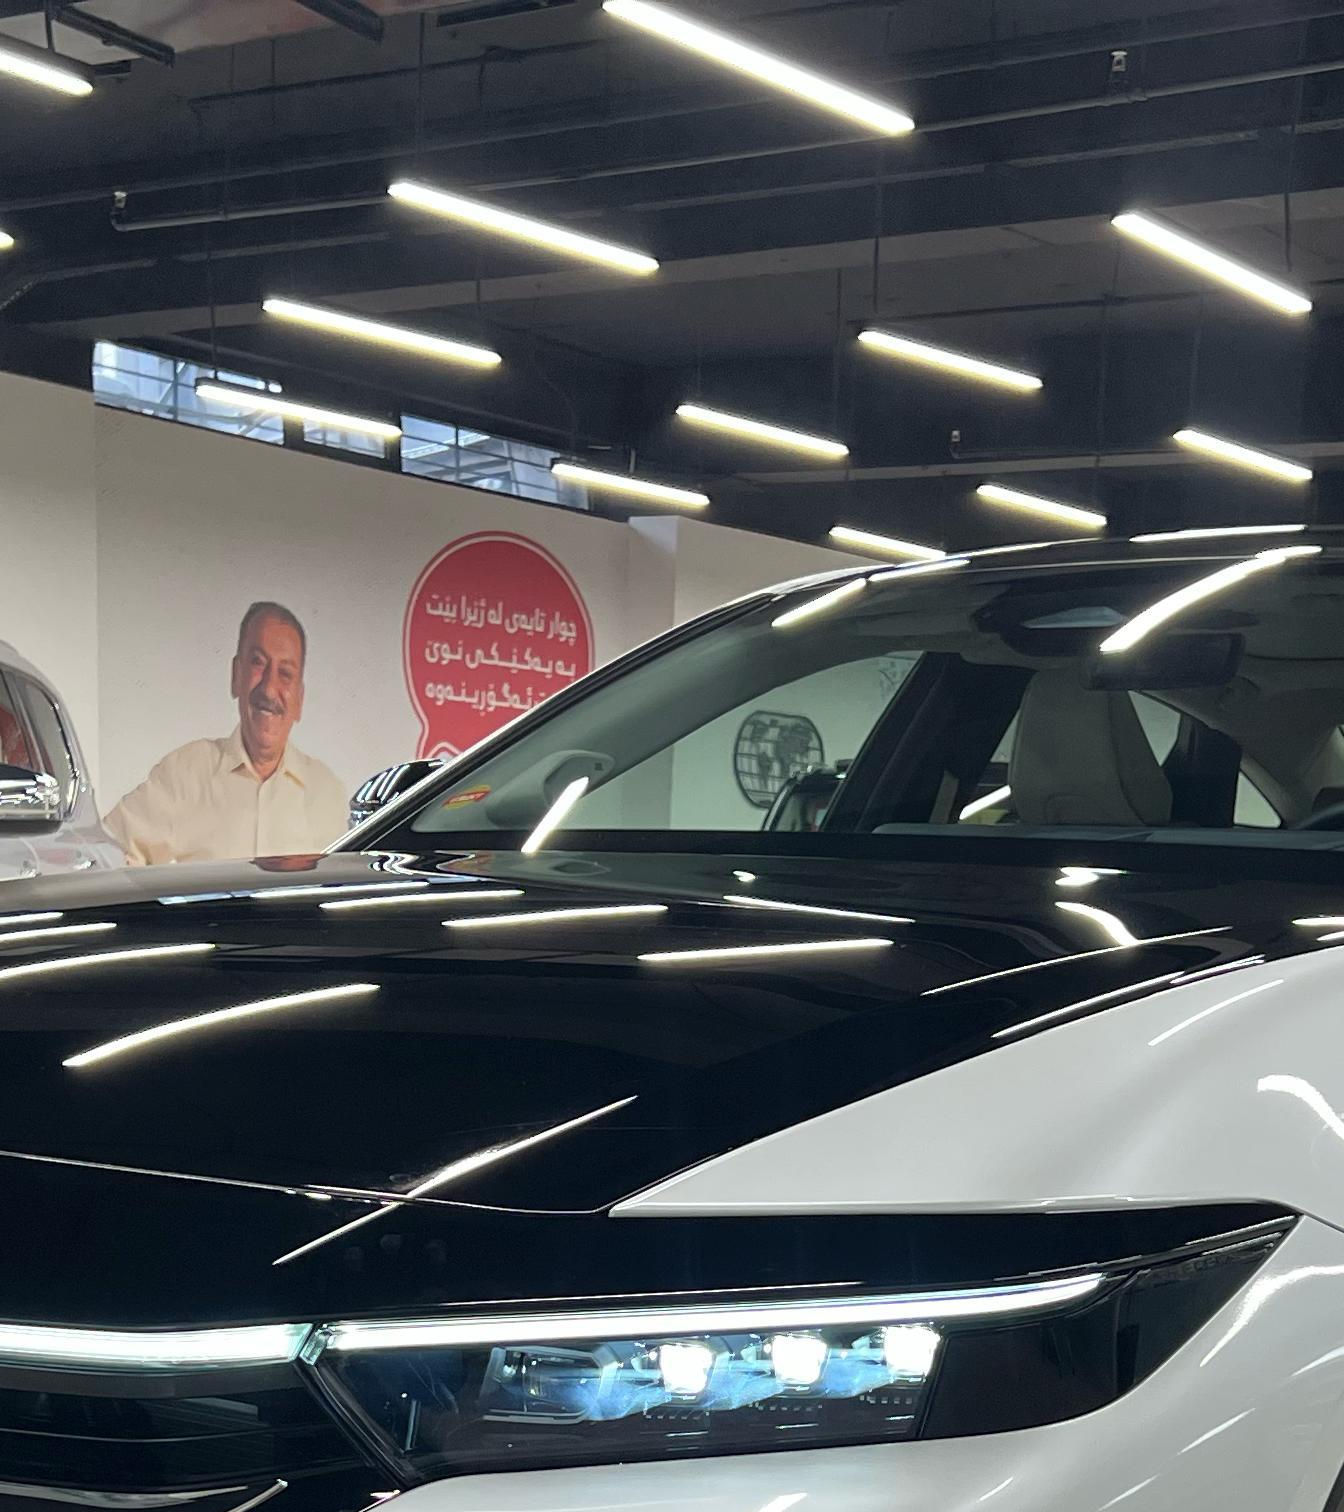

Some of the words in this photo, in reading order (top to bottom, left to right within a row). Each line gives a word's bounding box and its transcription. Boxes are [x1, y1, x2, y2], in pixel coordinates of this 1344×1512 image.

[487, 601, 503, 625] لە
[547, 611, 577, 646] چوار
[554, 660, 577, 684] بە
